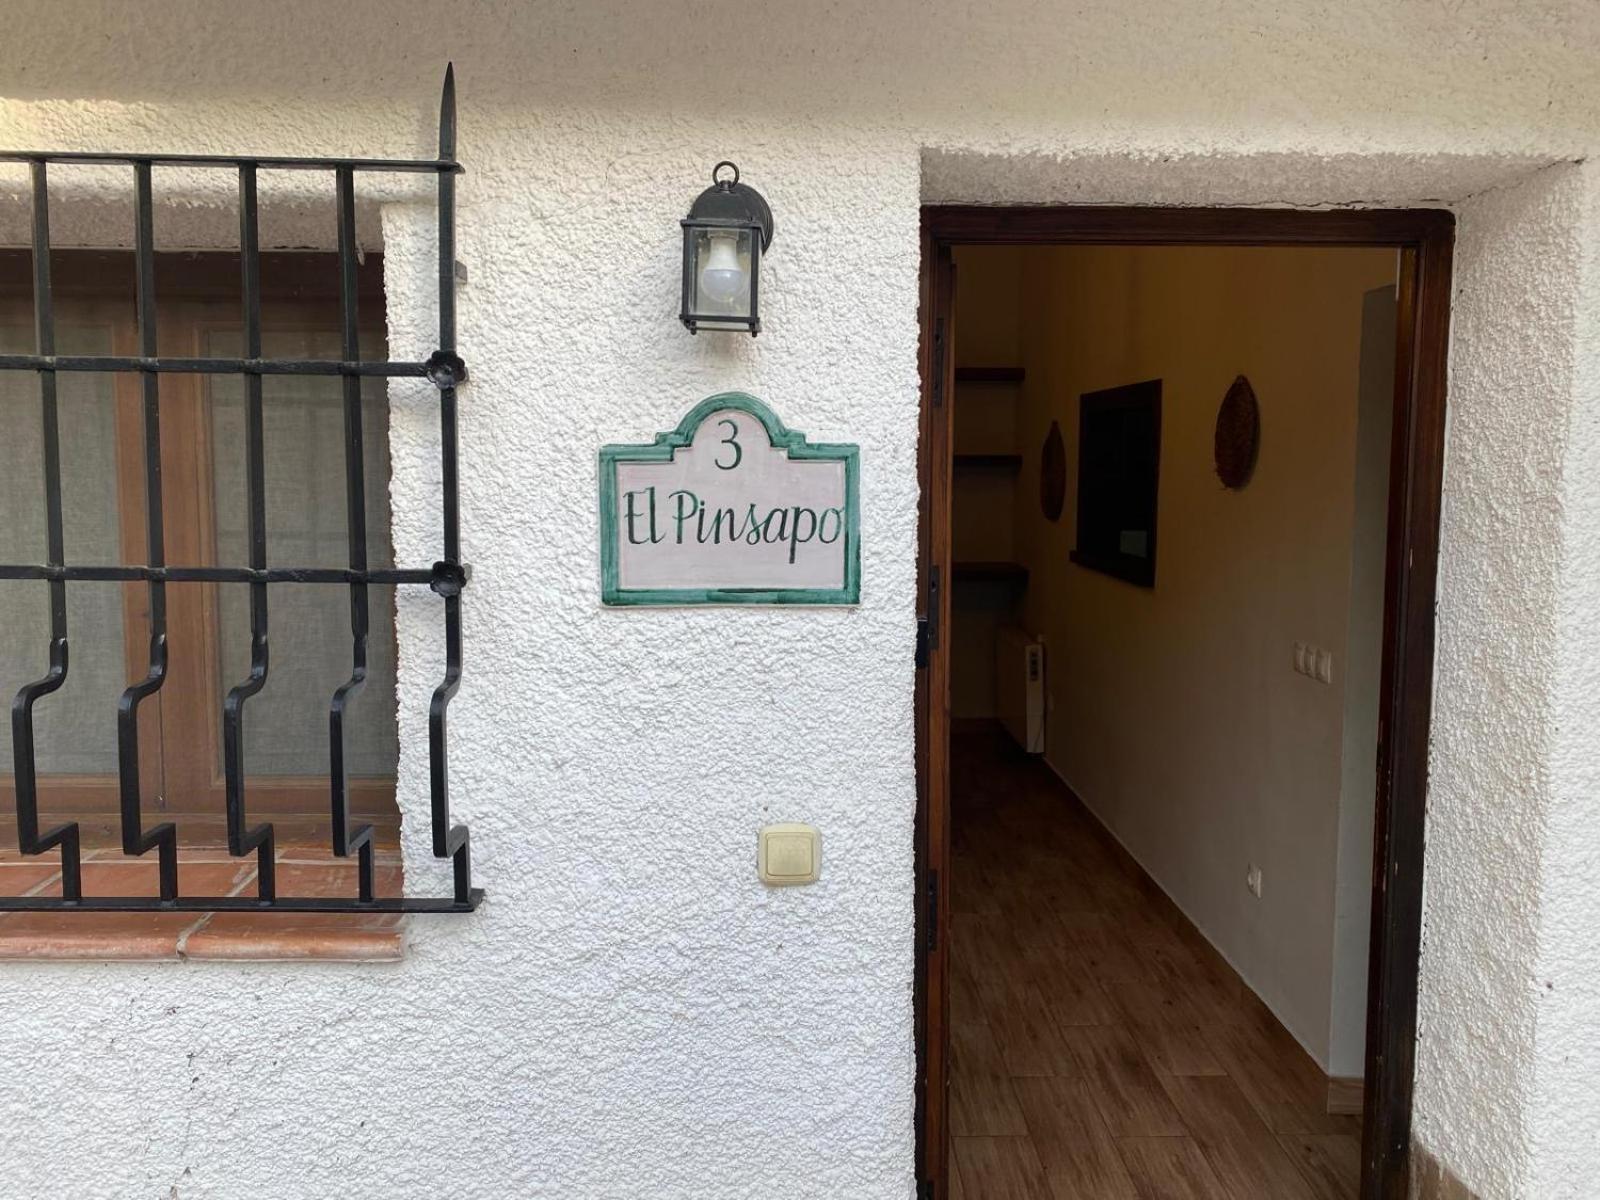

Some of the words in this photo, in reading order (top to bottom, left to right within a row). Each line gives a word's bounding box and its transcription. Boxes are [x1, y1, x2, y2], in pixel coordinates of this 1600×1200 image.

[714, 419, 742, 470] 3
[623, 486, 667, 544] El
[668, 489, 845, 564] Pinsapo
